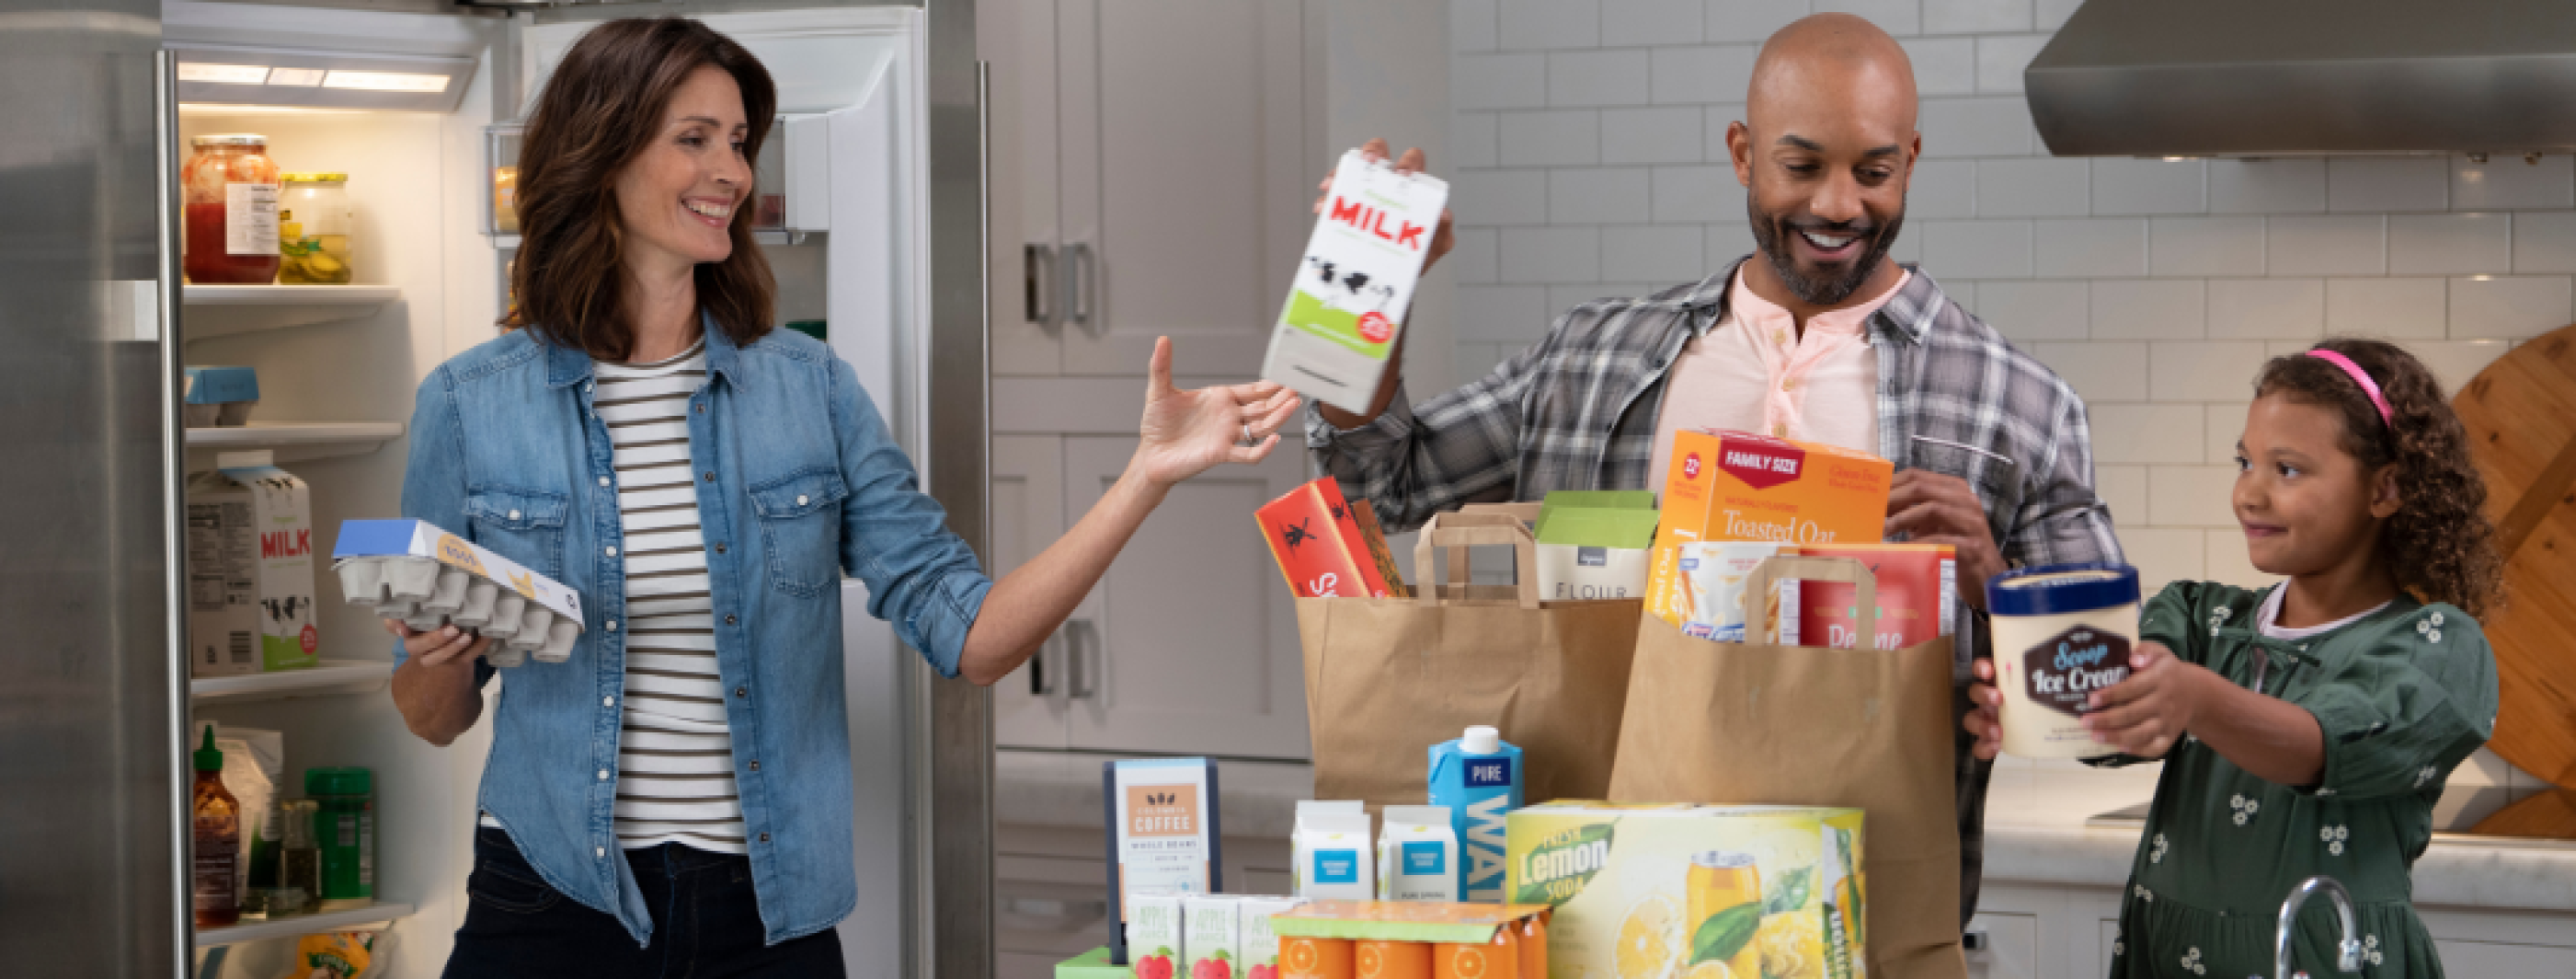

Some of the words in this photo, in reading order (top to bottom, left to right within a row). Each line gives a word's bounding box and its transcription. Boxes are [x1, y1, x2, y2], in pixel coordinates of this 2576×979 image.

[1330, 195, 1426, 251] MILK
[1725, 450, 1771, 470] FAMILY
[1772, 456, 1799, 475] SIZE
[1723, 509, 1796, 545] Toasted
[1799, 520, 1838, 544] Oat
[259, 528, 312, 559] MILK
[1555, 582, 1627, 600] FLOUR
[2054, 640, 2108, 671] Scoop
[2032, 668, 2065, 695] Ice
[1472, 765, 1502, 782] PURE
[1134, 815, 1191, 832] COFFEE
[1518, 838, 1608, 886] Lemon
[1545, 875, 1584, 902] SODA
